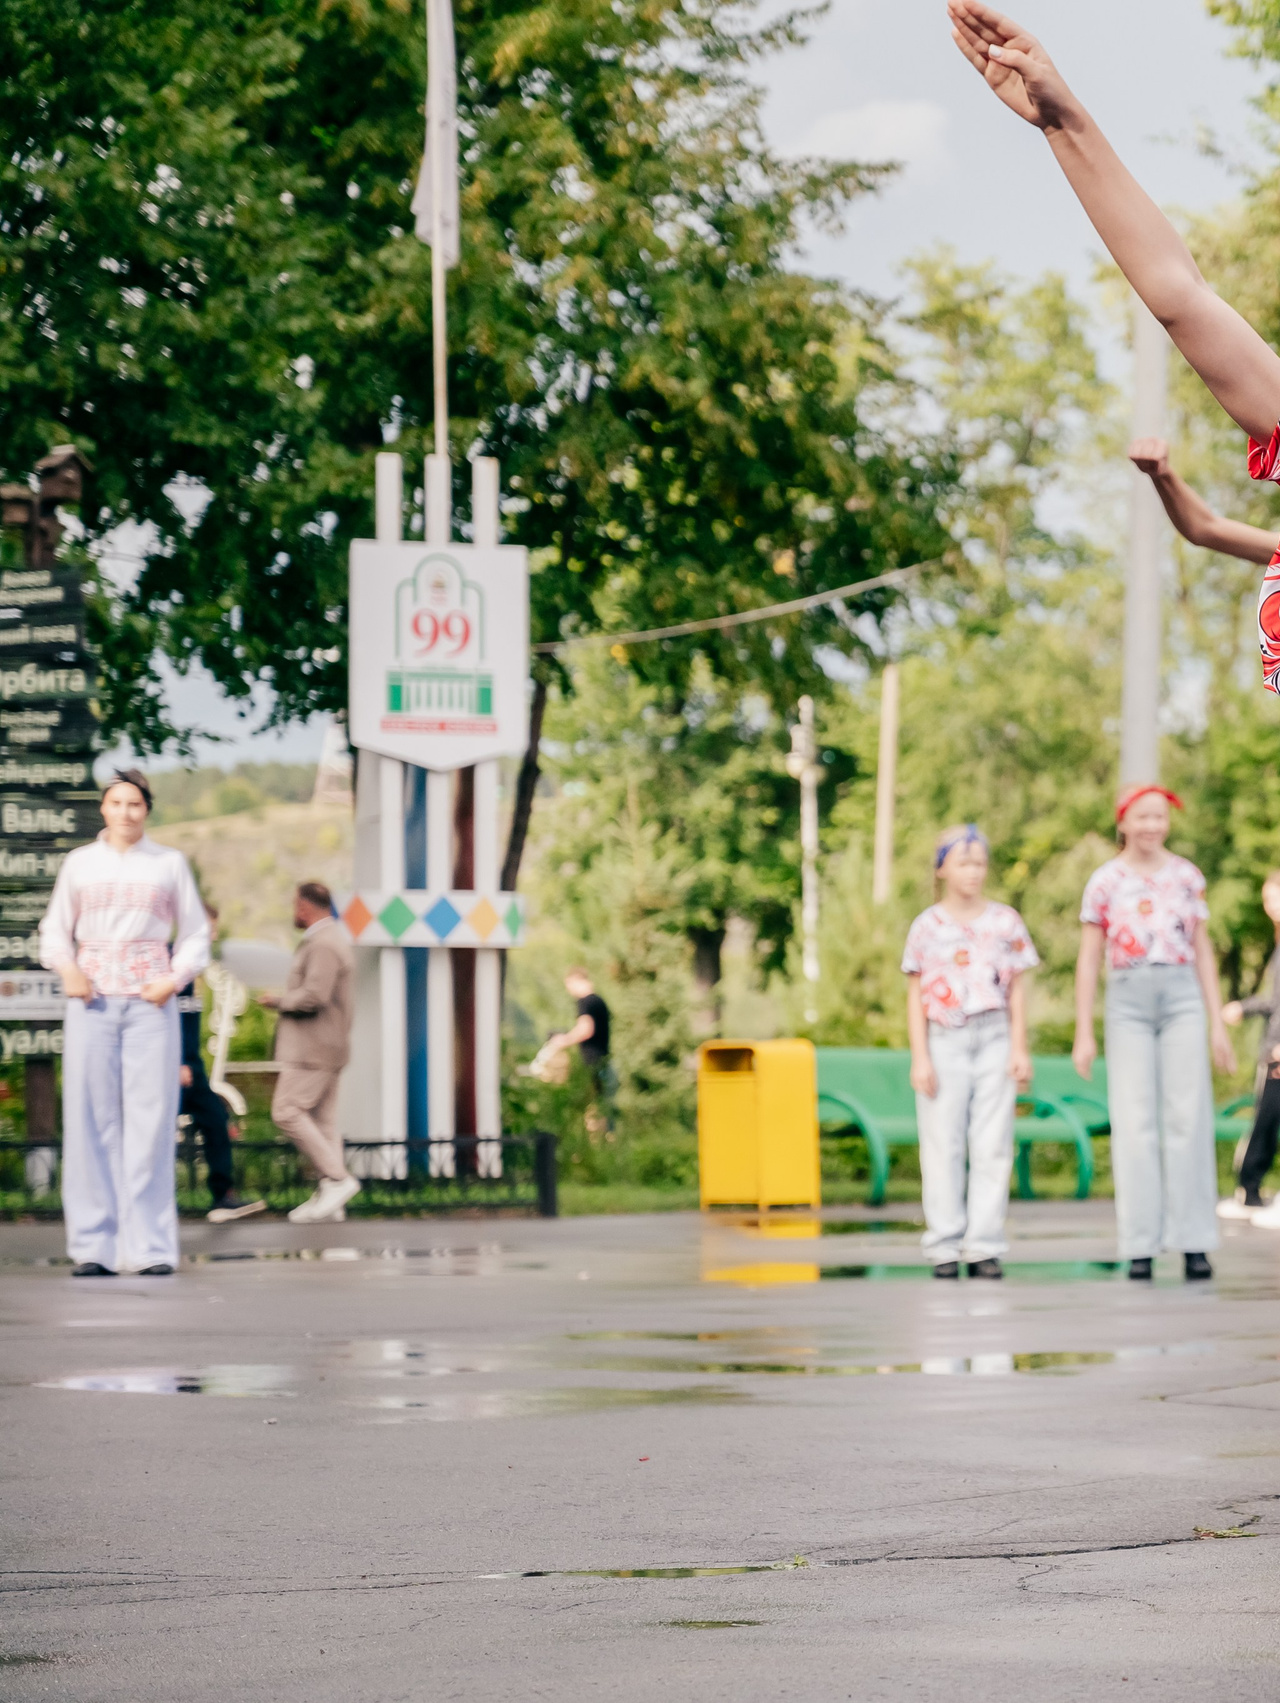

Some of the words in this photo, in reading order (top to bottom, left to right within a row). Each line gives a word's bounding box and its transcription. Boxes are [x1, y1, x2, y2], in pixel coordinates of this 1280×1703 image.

[411, 608, 471, 658] 99
[0, 663, 85, 700] рбита
[3, 803, 76, 833] Вальс
[0, 1028, 63, 1061] уале
